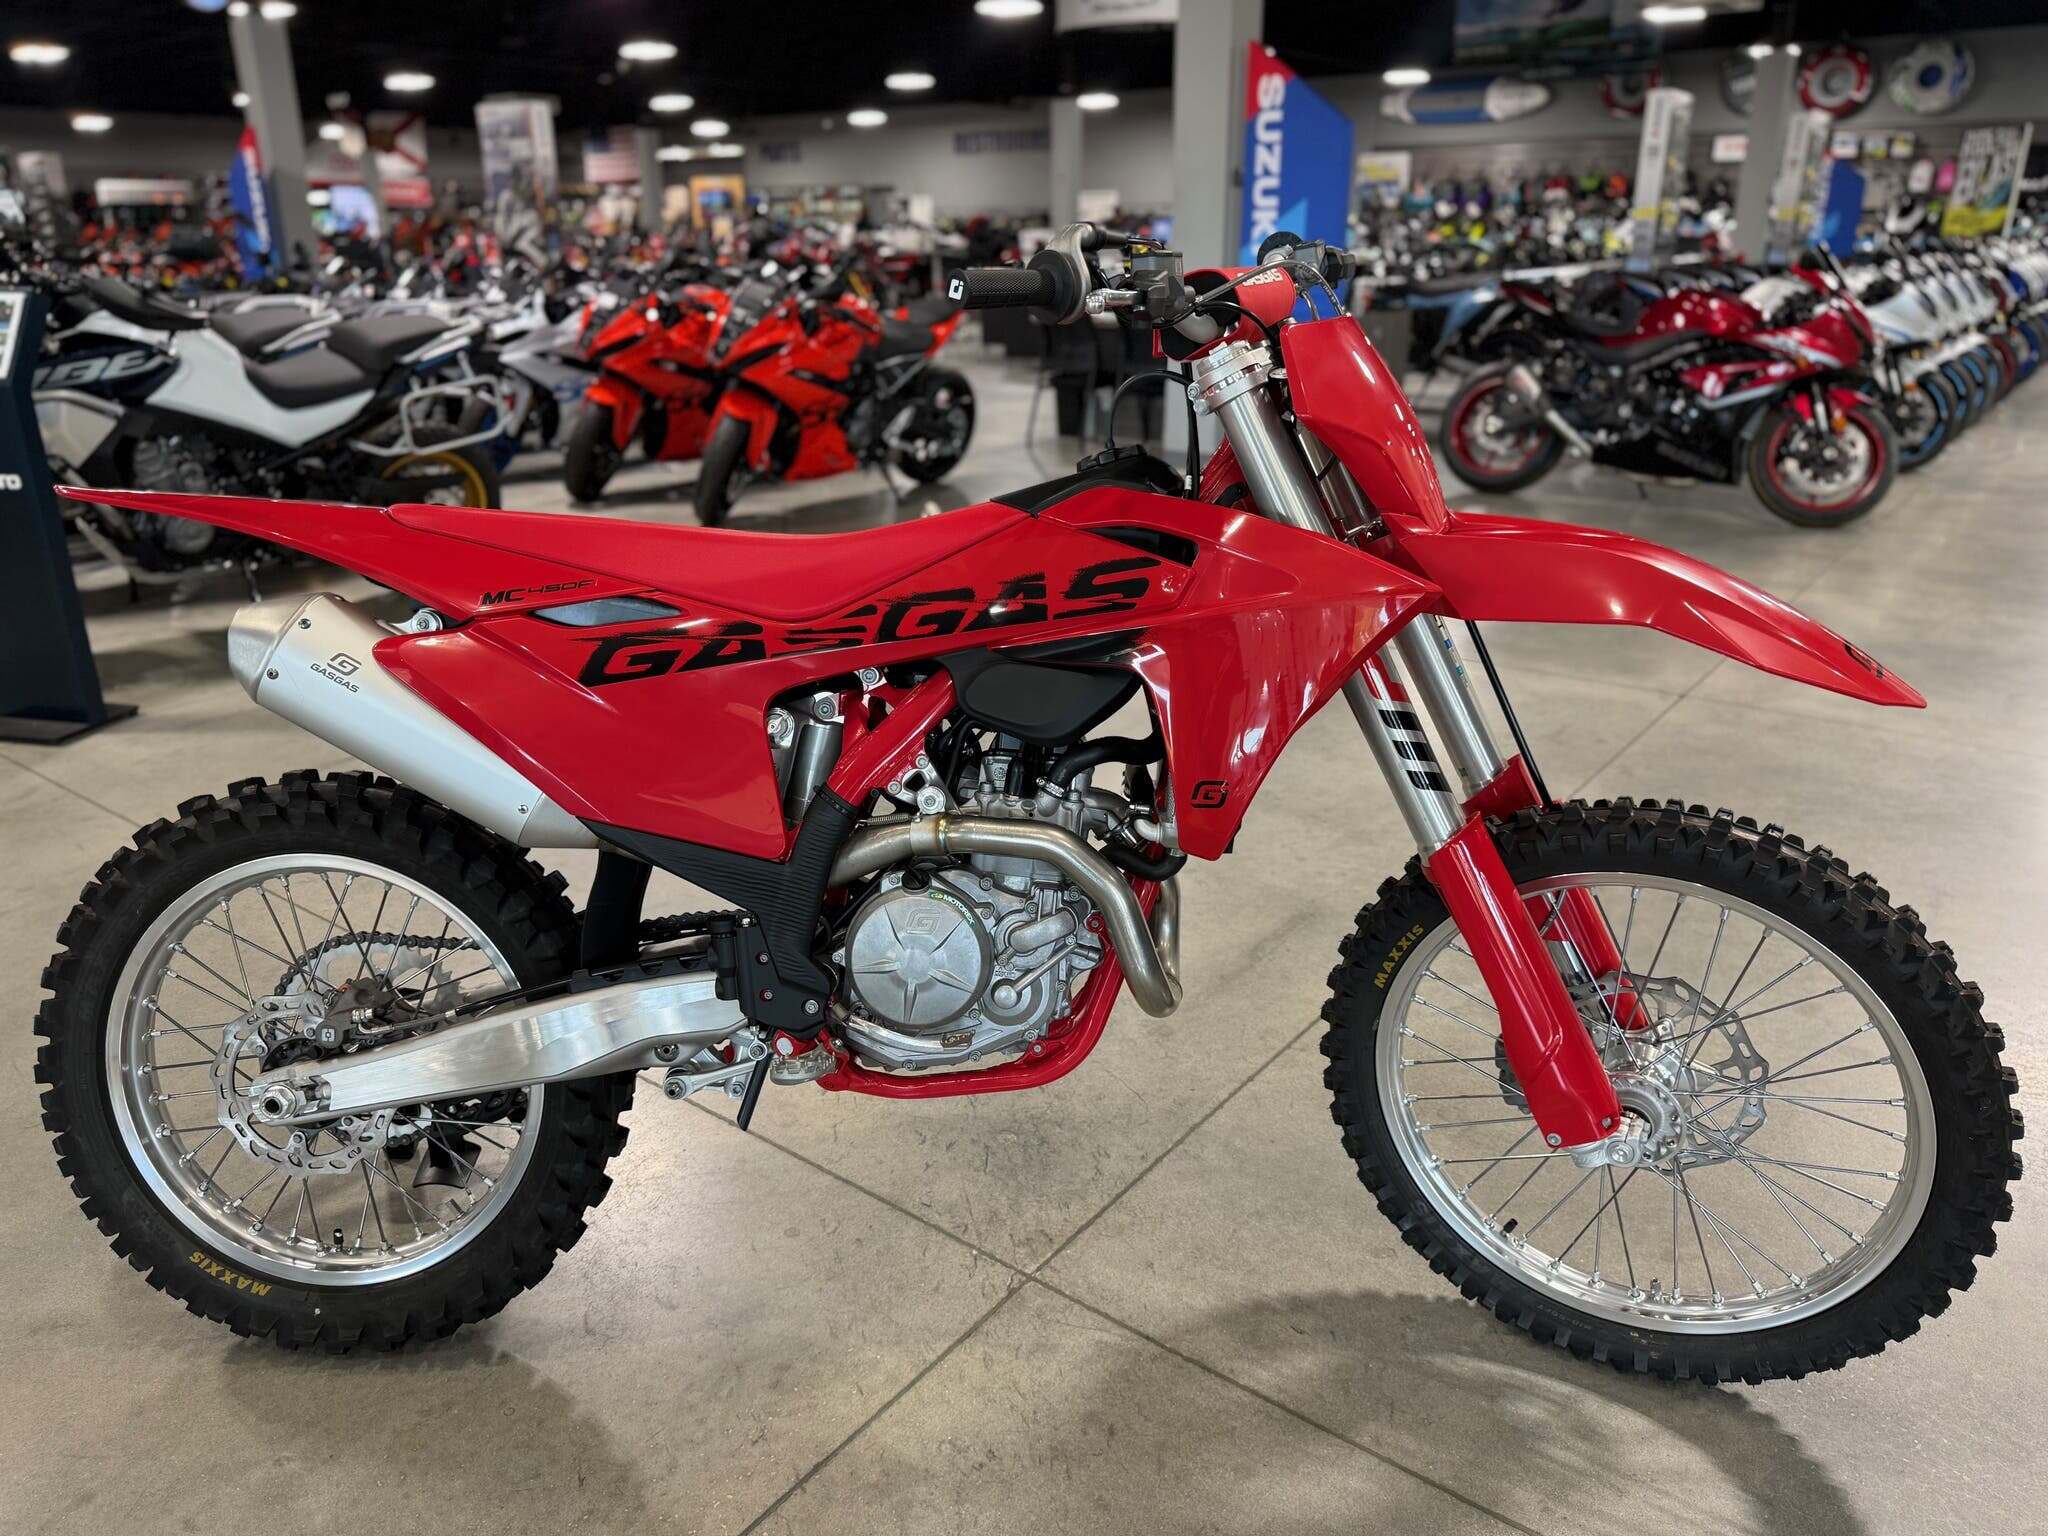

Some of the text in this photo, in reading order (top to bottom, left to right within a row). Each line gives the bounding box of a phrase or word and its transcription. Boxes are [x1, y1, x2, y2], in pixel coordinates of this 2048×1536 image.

[481, 579, 595, 605] MC 450F
[575, 556, 1162, 688] GASGAS
[310, 663, 360, 693] GASGAS
[942, 894, 976, 926] MOTOREX
[1374, 924, 1425, 989] MAXXIS
[189, 1251, 272, 1297] MAXXIS
